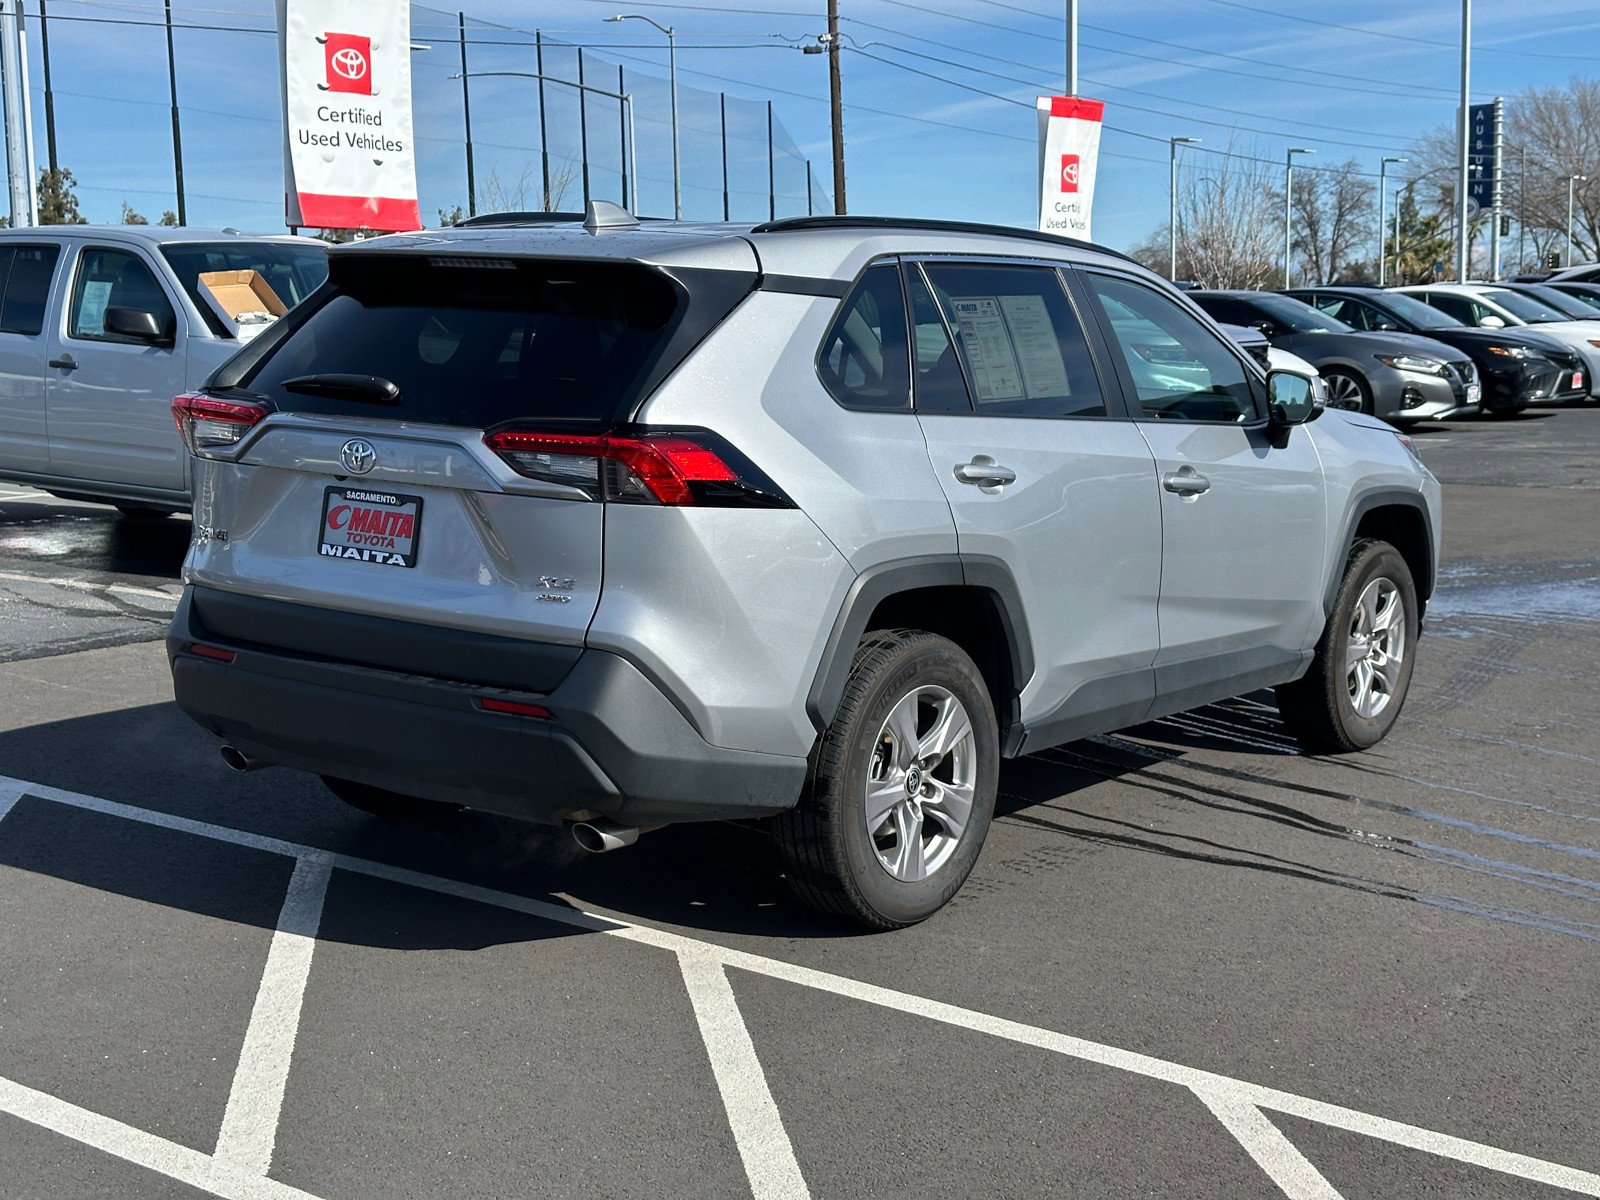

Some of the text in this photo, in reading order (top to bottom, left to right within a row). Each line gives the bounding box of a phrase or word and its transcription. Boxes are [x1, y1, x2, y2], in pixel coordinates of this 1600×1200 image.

[317, 106, 382, 126] Certified
[298, 129, 403, 152] Used Vehicles
[1474, 110, 1485, 195] AUBURN
[1046, 217, 1067, 229] Used
[346, 490, 396, 504] SACRAMENTO
[346, 532, 395, 549] TOYOTA
[321, 543, 406, 566] MAITA
